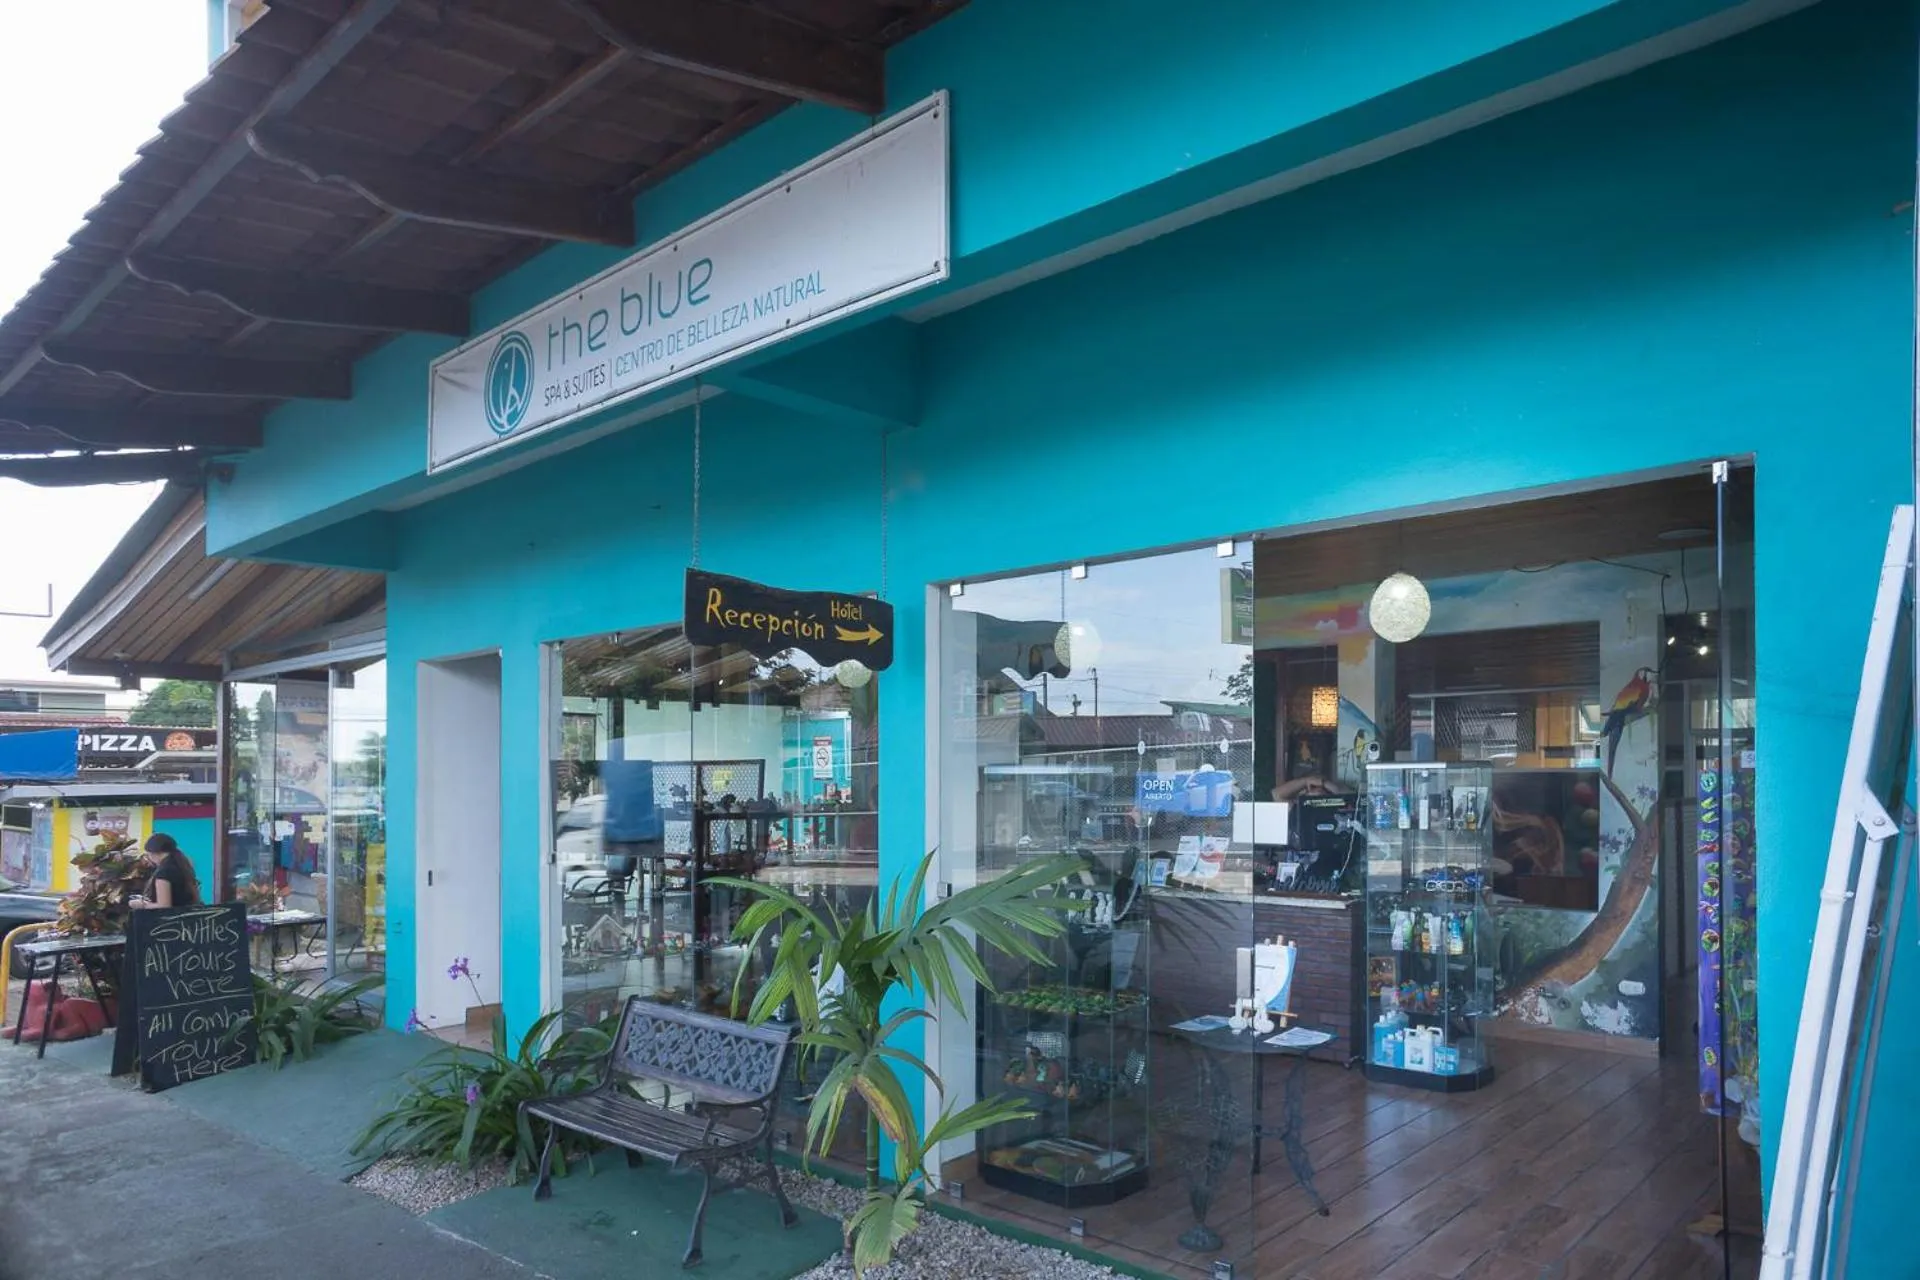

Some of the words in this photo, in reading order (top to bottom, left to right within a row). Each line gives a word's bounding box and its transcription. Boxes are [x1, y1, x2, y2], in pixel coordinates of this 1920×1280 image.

[547, 308, 609, 371] the
[620, 257, 713, 336] blue
[544, 382, 561, 407] SPA
[564, 374, 571, 399] &
[573, 363, 605, 394] SUITES
[615, 339, 663, 377] CENTRO
[667, 328, 685, 356] DE
[687, 301, 750, 346] BELLEZA
[753, 270, 825, 319] NATURAL
[706, 587, 825, 643] Recepción
[831, 600, 863, 621] Hotel
[78, 734, 156, 751] PIZZA
[1143, 779, 1173, 791] OPEN
[145, 943, 170, 977] All
[149, 1012, 172, 1039] All
[174, 1055, 242, 1082] Here
